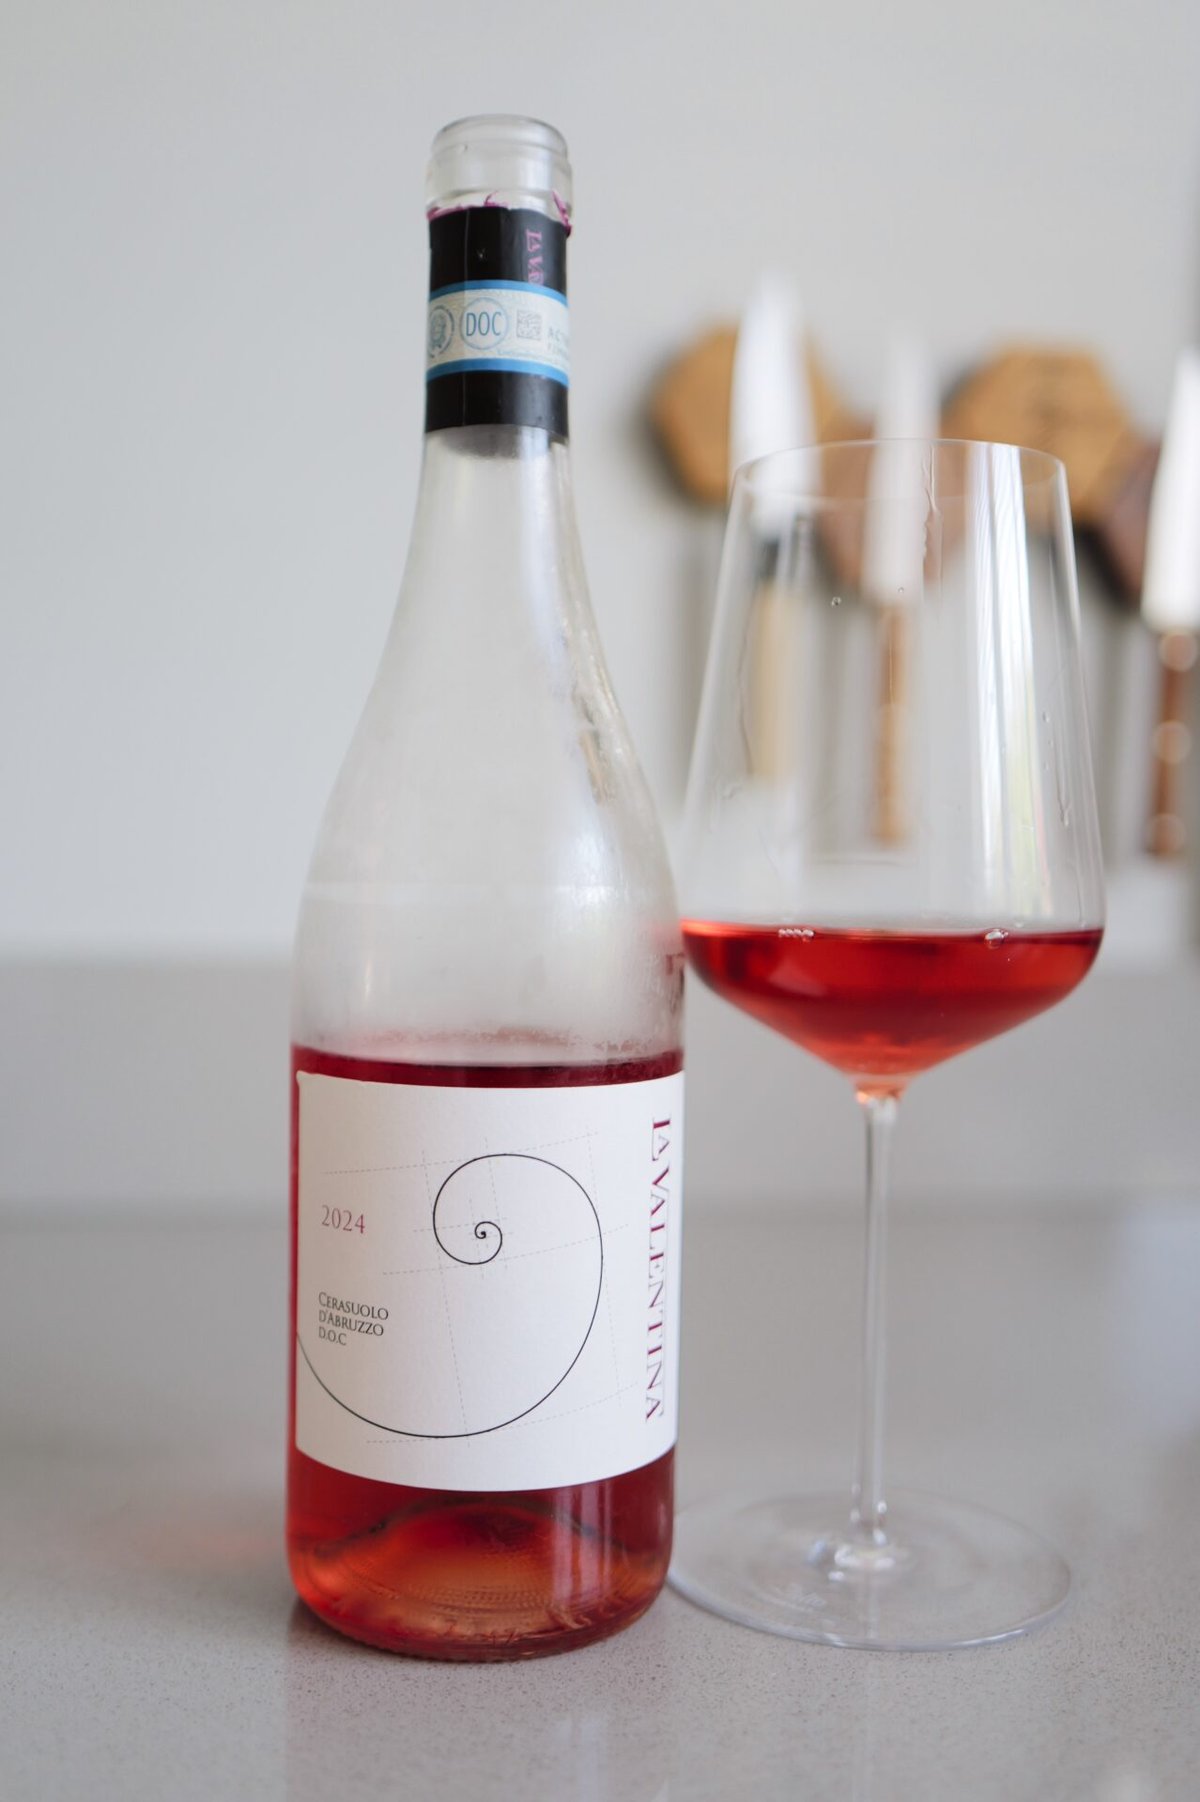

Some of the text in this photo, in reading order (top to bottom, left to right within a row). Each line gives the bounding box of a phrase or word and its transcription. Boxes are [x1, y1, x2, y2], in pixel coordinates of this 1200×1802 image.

[465, 311, 502, 337] DOC
[321, 1204, 366, 1234] 2024
[645, 1114, 671, 1423] LA VALENTINA
